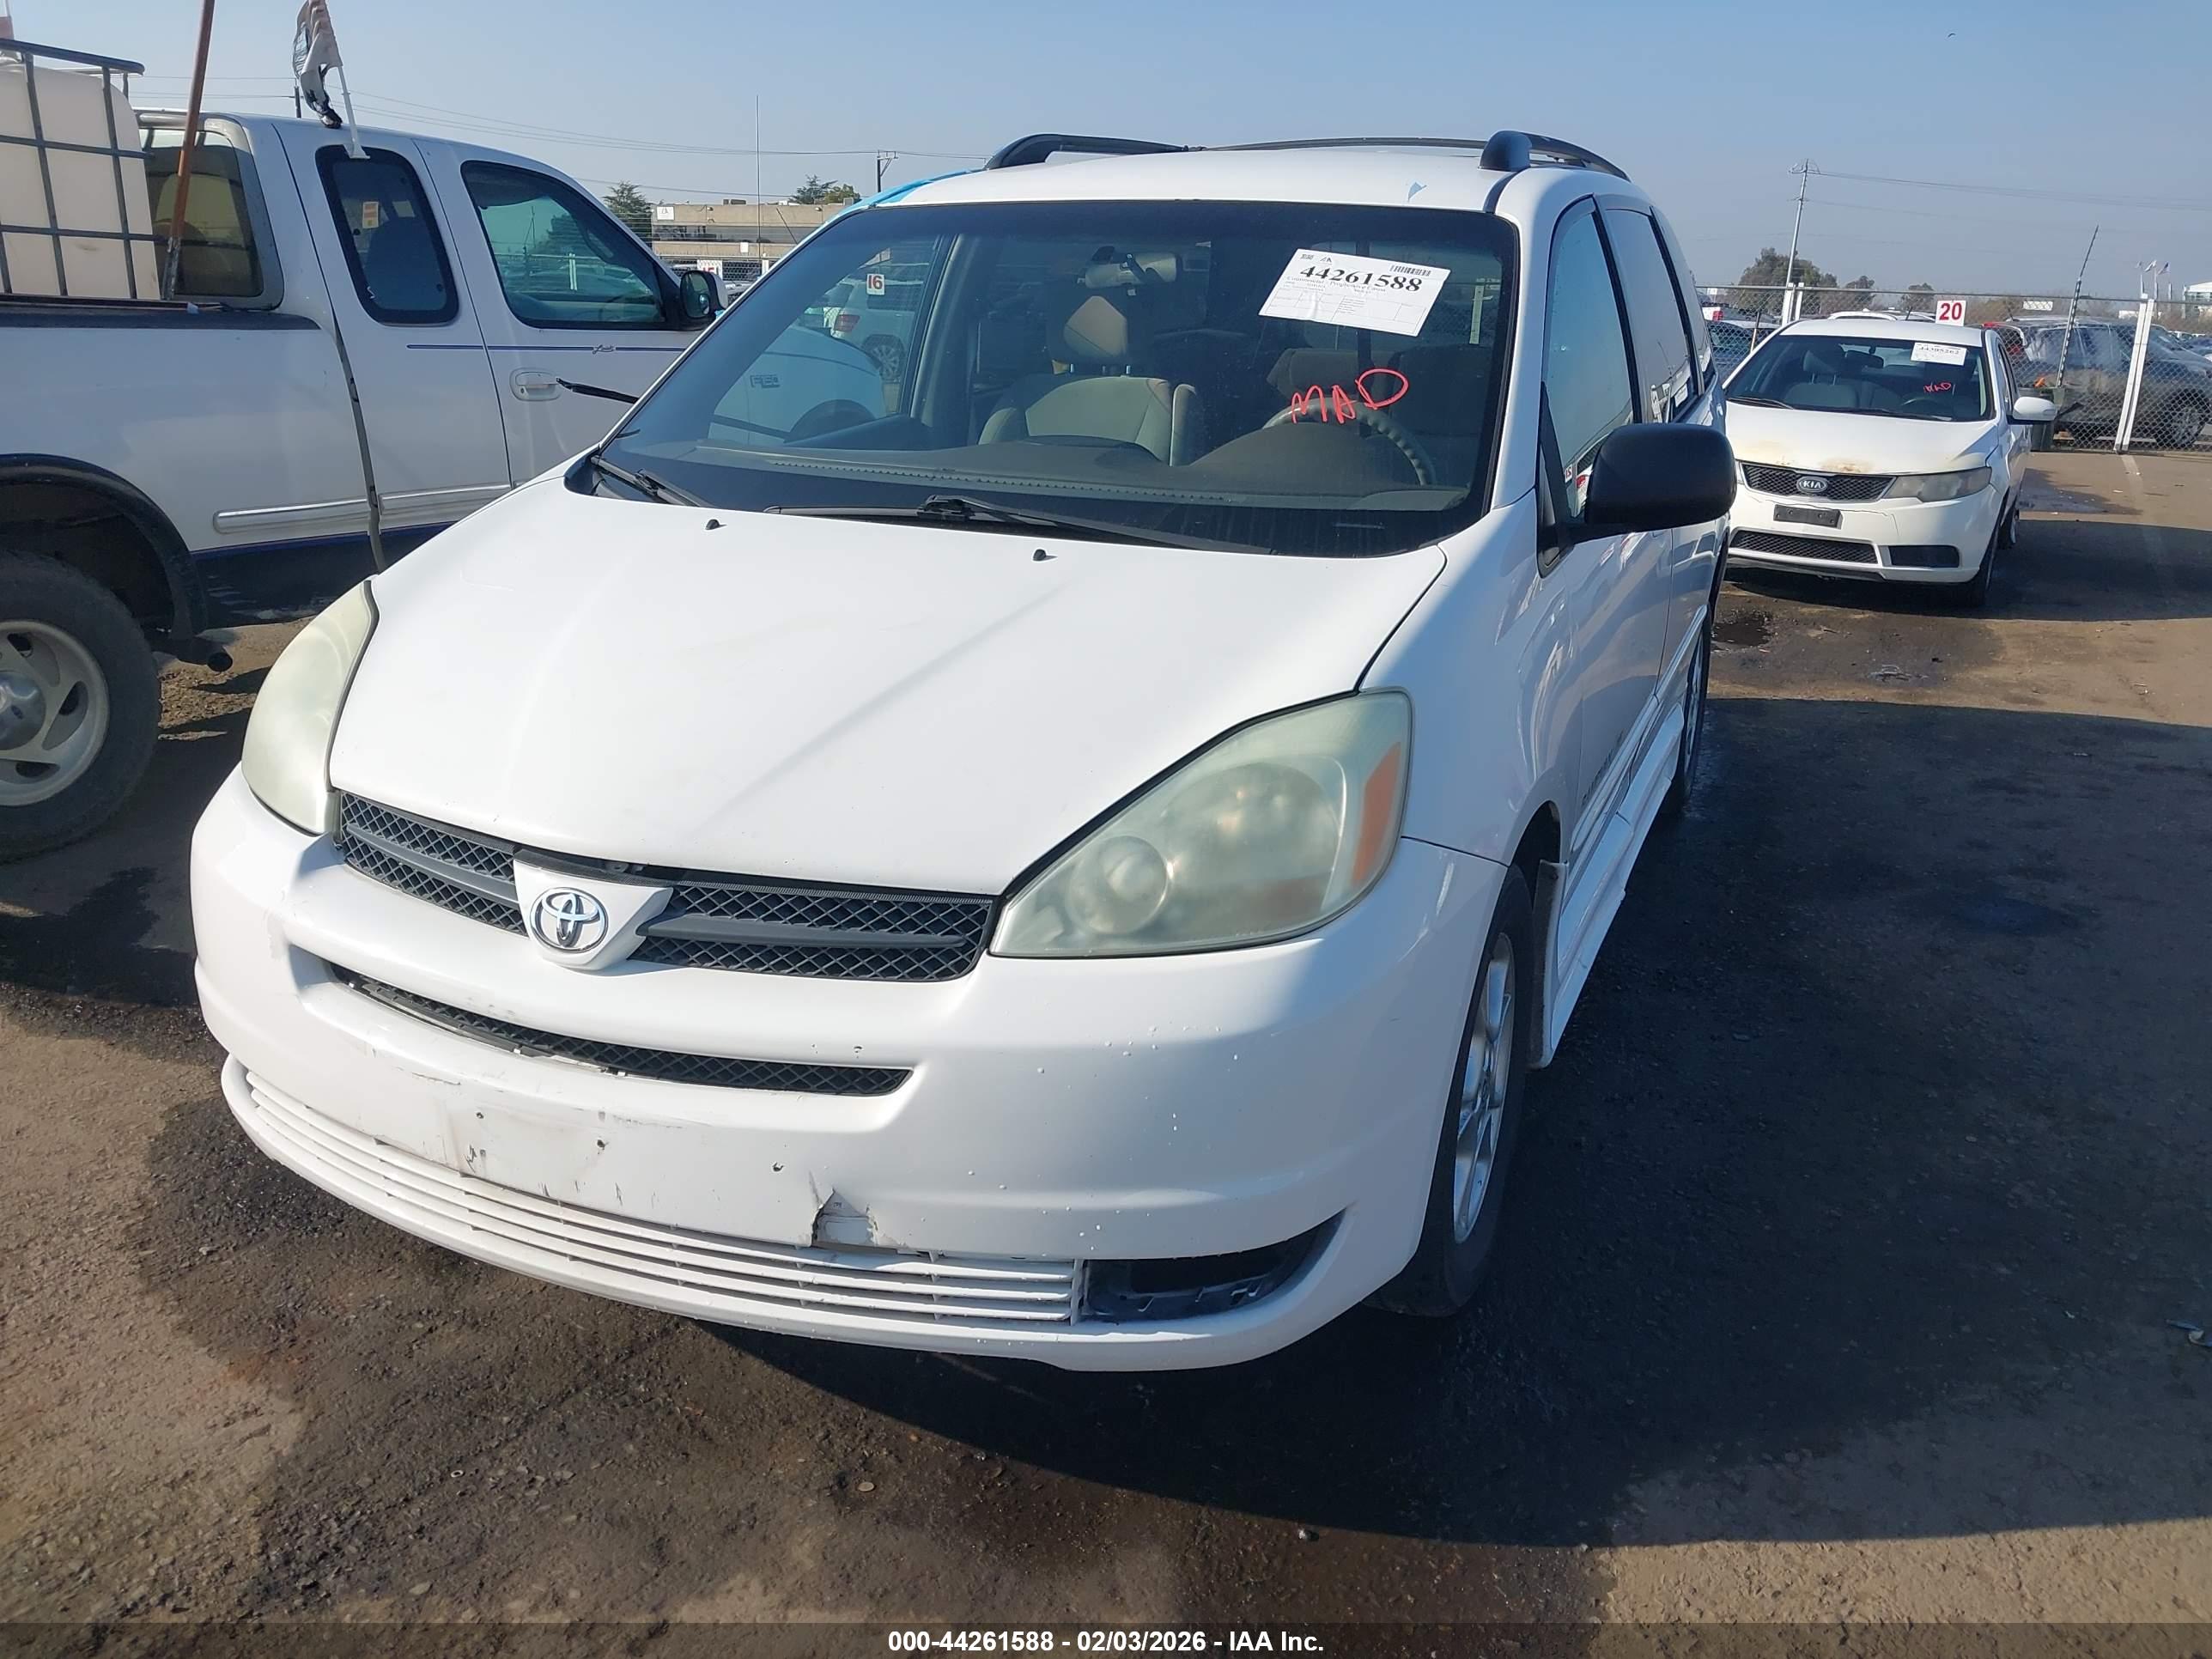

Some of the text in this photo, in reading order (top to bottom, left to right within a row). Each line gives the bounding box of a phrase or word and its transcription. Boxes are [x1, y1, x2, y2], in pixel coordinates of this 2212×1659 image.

[868, 275, 883, 289] 16
[1300, 265, 1422, 291] 44261588
[1939, 302, 1963, 321] 20
[1803, 480, 1821, 489] KIA
